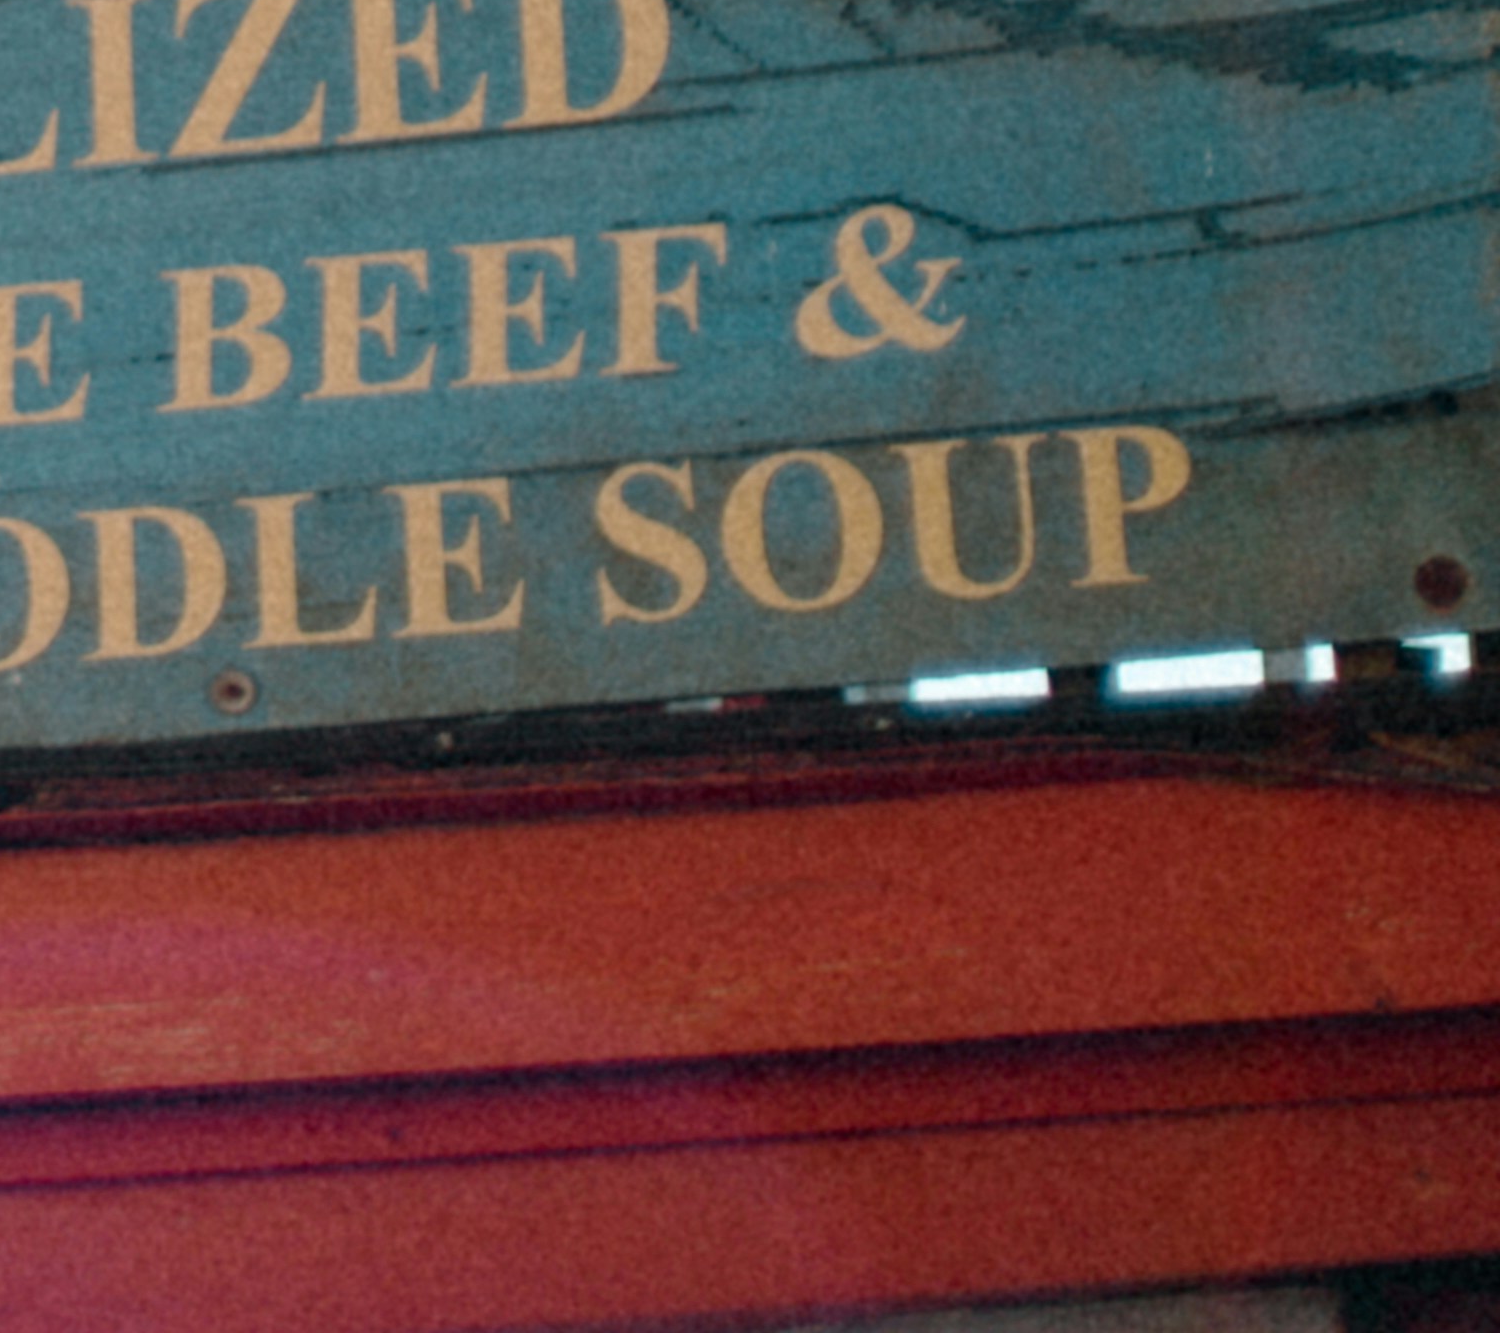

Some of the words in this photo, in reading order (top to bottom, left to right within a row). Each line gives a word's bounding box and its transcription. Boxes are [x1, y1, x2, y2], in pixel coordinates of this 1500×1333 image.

[156, 221, 727, 415] BEEF
[793, 202, 966, 360] &
[594, 424, 1193, 629] SOUP
